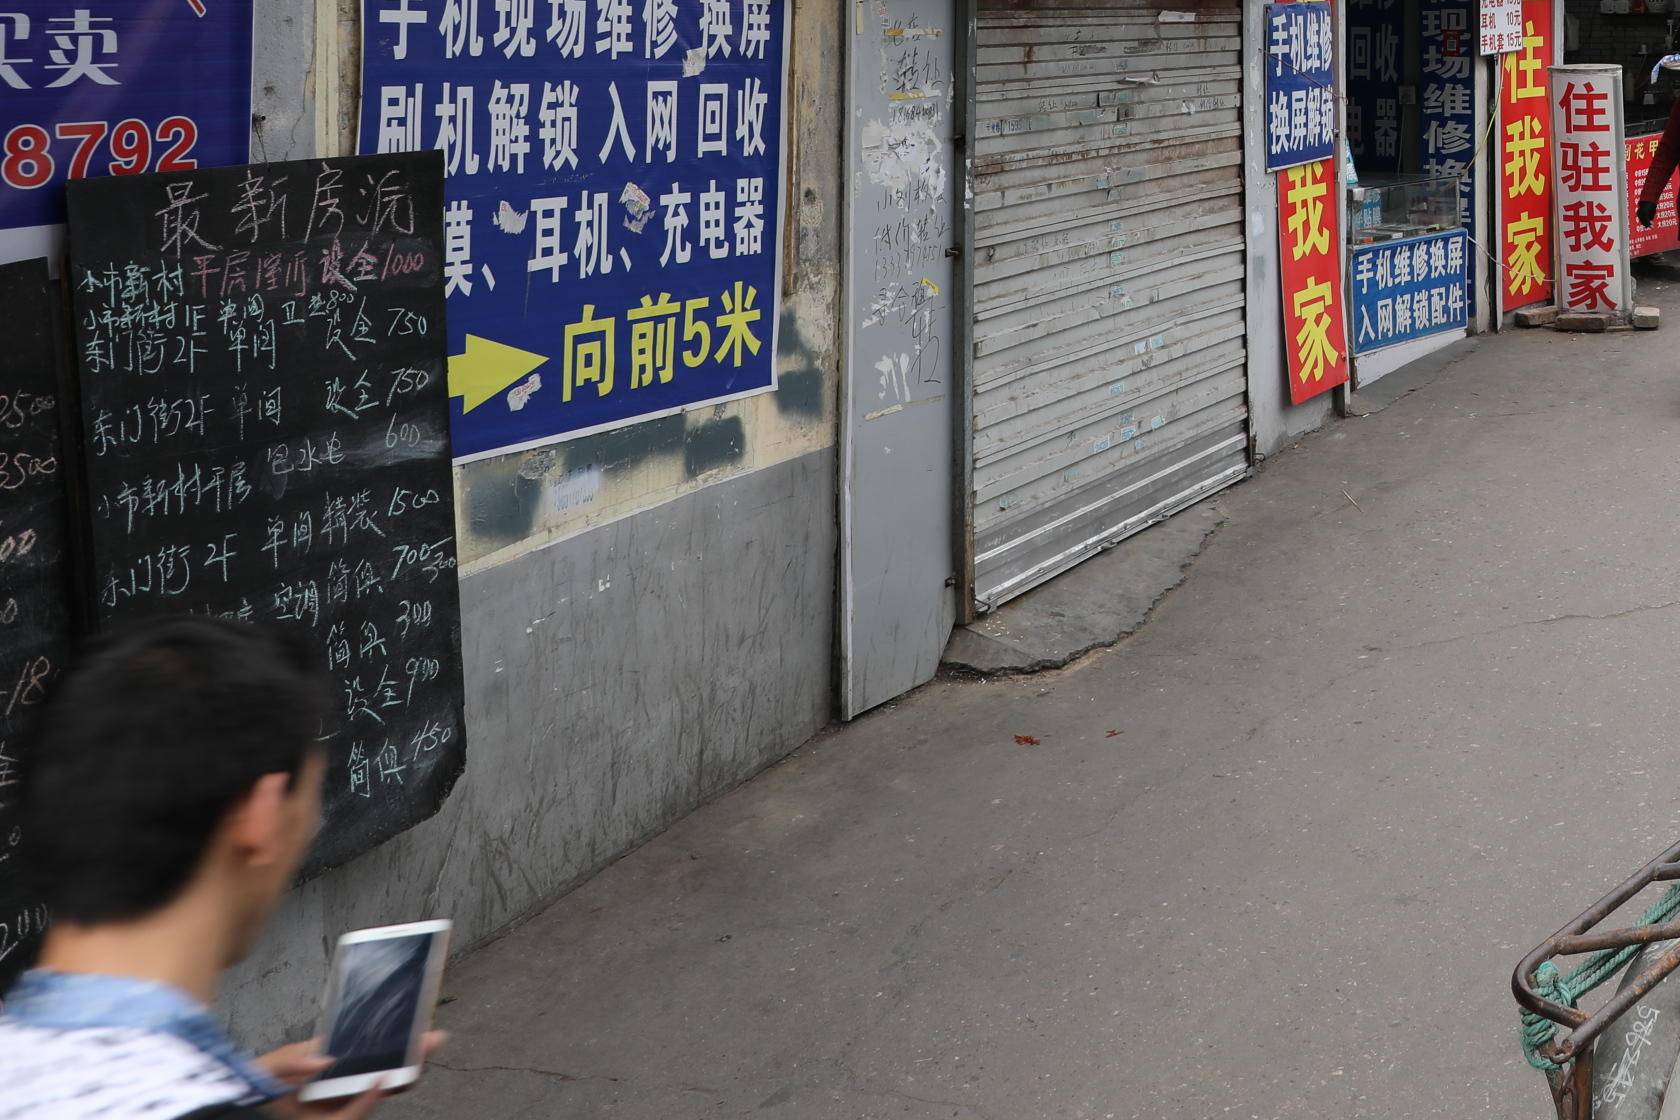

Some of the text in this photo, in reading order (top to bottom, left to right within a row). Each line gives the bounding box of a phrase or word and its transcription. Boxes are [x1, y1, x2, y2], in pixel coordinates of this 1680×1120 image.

[1270, 10, 1333, 78] 手机维修
[1481, 10, 1521, 31] 耳机 10元
[1481, 31, 1521, 53] 手机套 15元
[378, 77, 769, 179] 刷机解锁 入网 回收
[1270, 84, 1334, 156] 换屏解锁
[1559, 81, 1618, 312] 住驻我家
[1356, 235, 1464, 295] 手机维修换屏
[562, 280, 762, 403] 向前5米
[1358, 282, 1464, 344] 入网解锁配件
